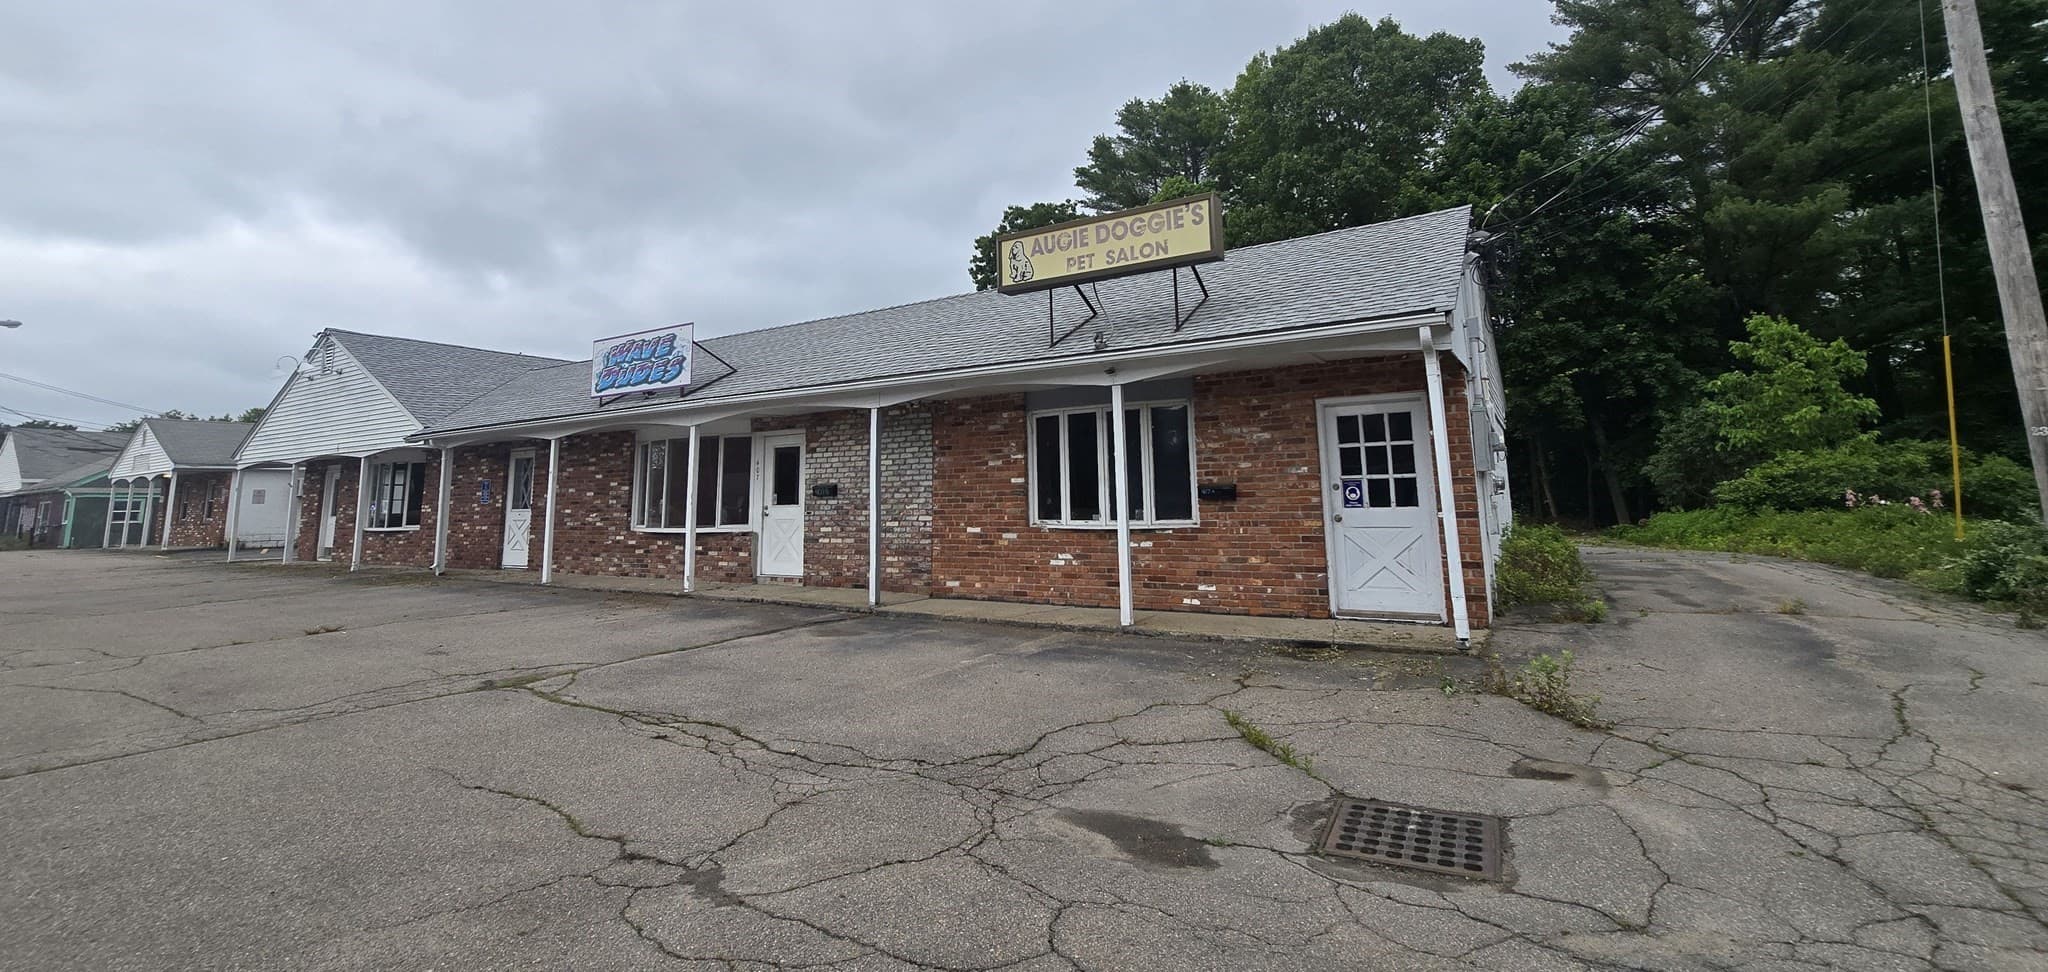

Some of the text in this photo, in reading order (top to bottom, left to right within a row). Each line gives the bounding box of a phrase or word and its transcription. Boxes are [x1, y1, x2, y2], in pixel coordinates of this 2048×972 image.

[1031, 203, 1205, 257] AUGIE DOGGIE'S
[1066, 239, 1169, 273] PET SALON
[607, 333, 677, 367] WAVE
[595, 355, 686, 393] DUDES
